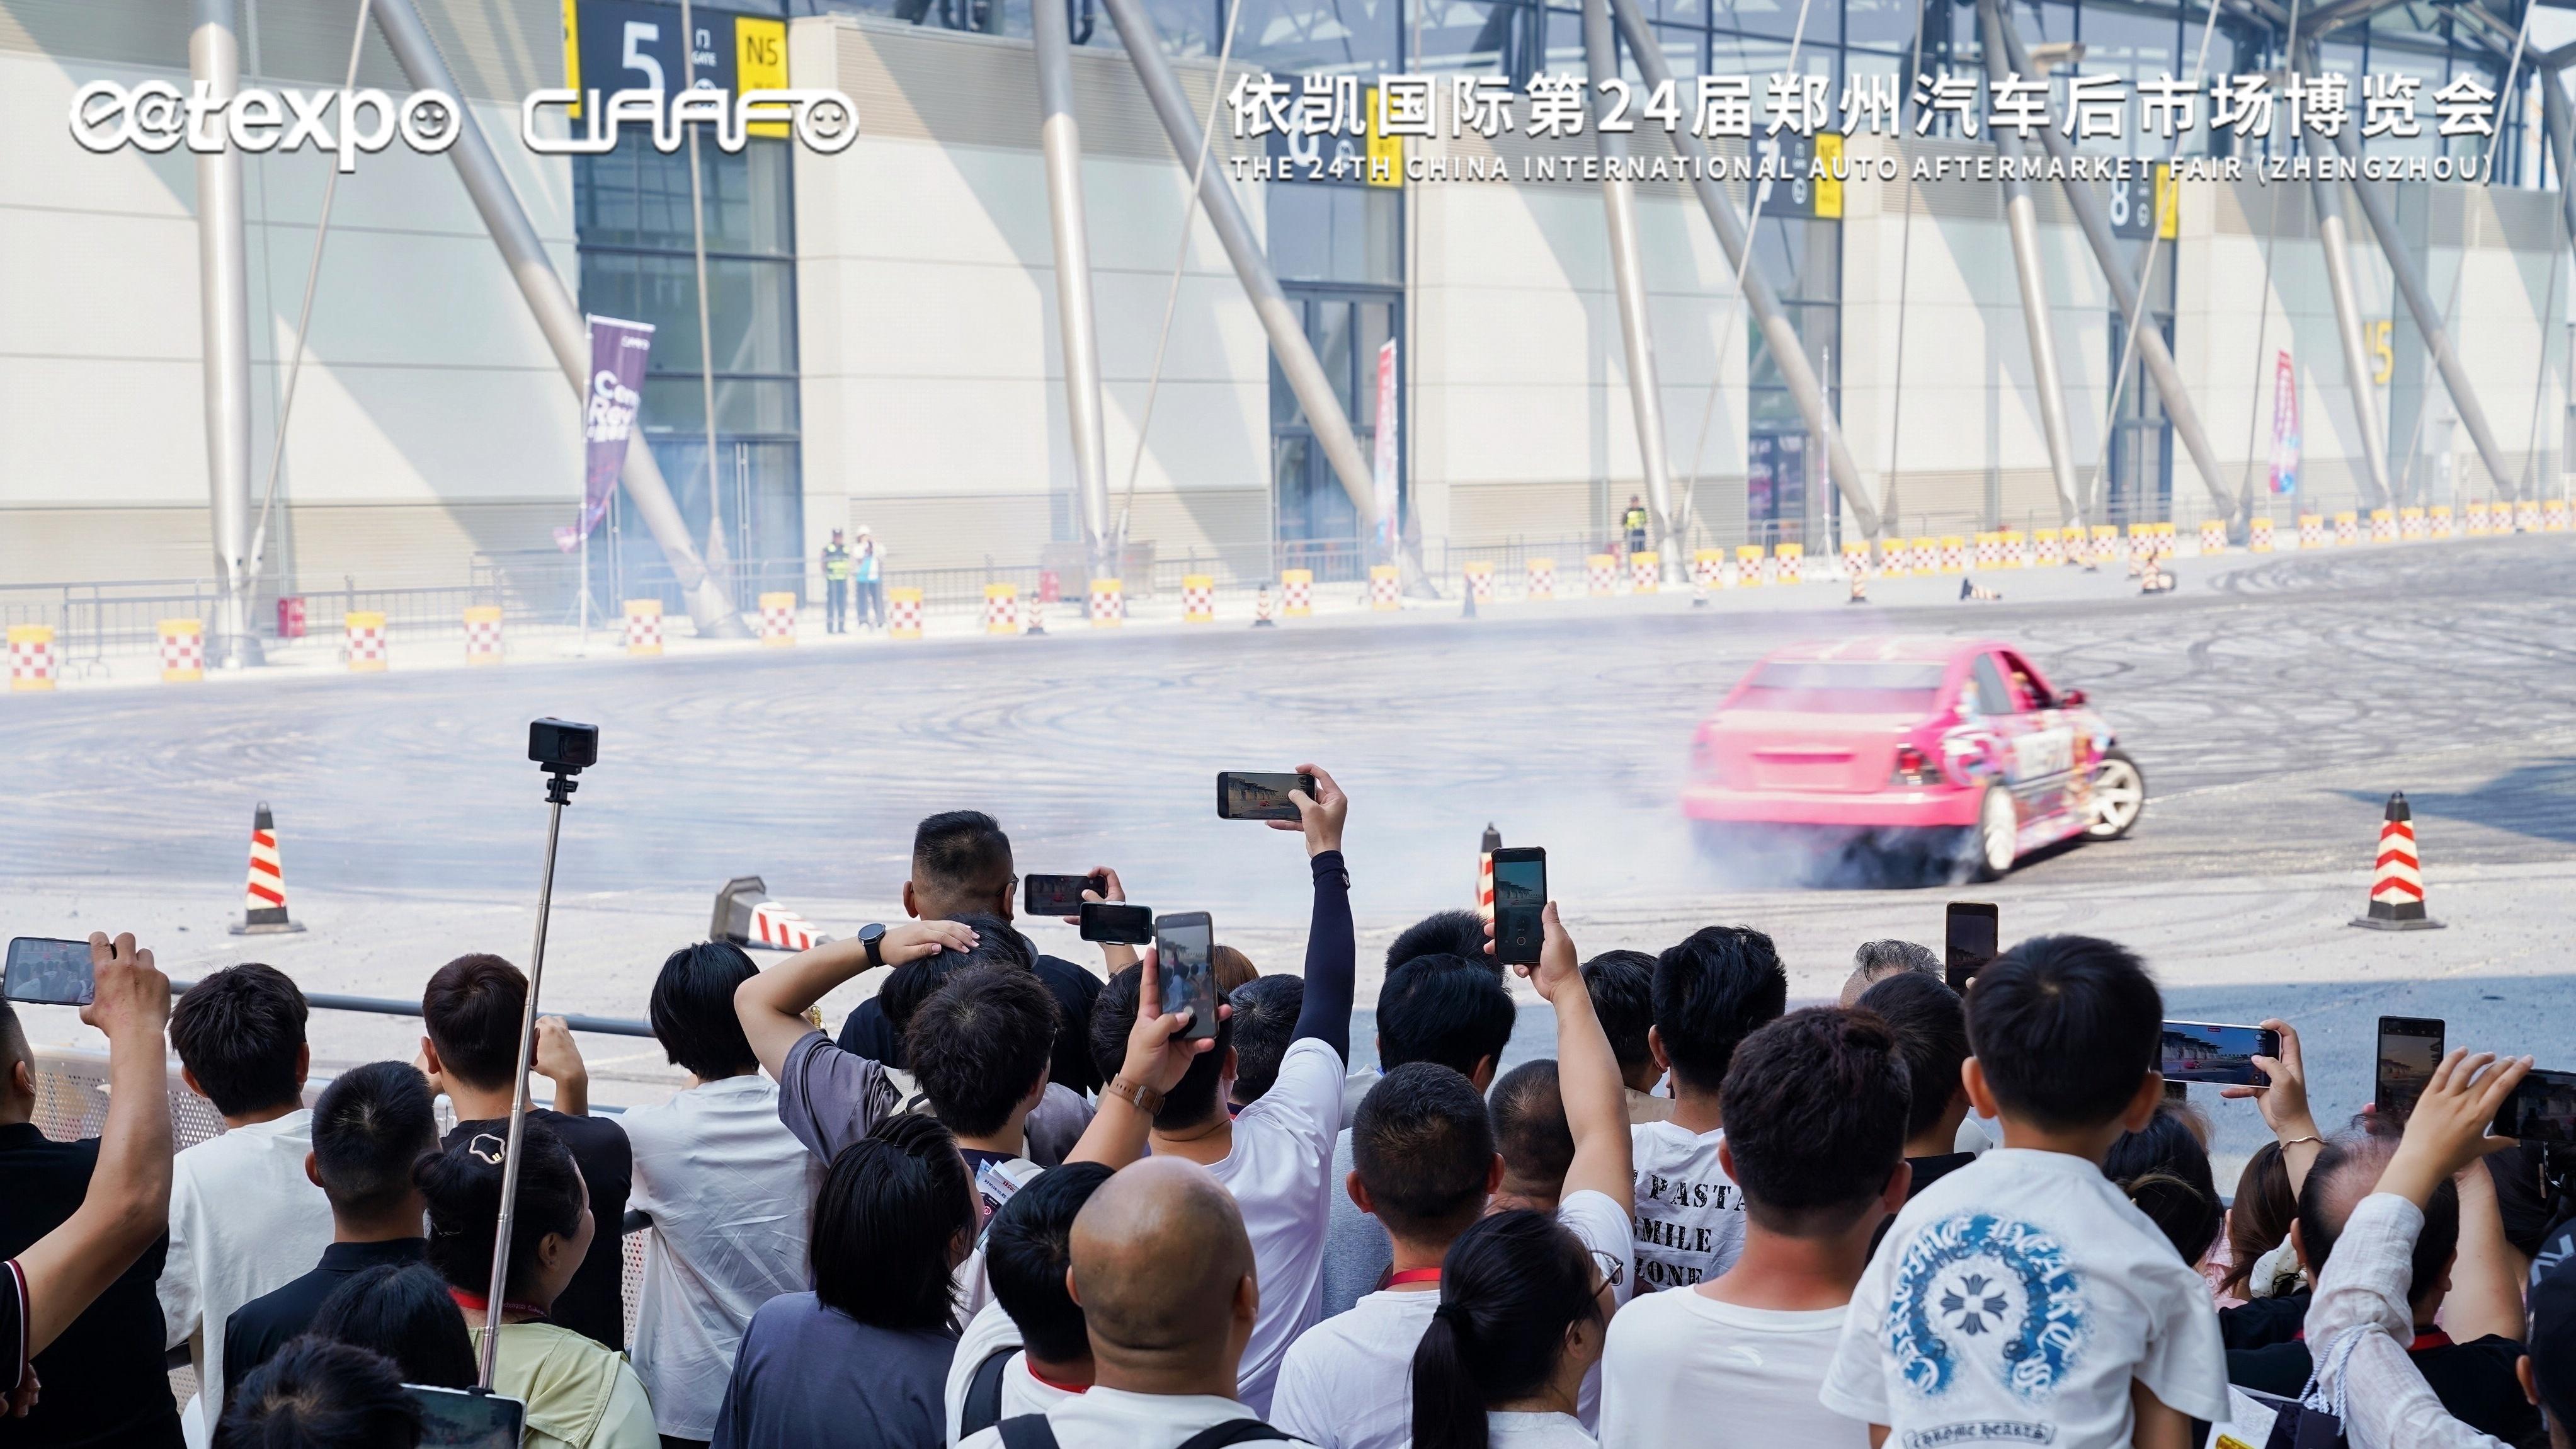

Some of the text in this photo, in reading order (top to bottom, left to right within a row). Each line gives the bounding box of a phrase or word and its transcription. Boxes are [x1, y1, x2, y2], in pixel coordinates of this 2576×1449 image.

[691, 50, 717, 67] GATE
[747, 35, 778, 66] N5
[1634, 1216, 1712, 1253] MILE
